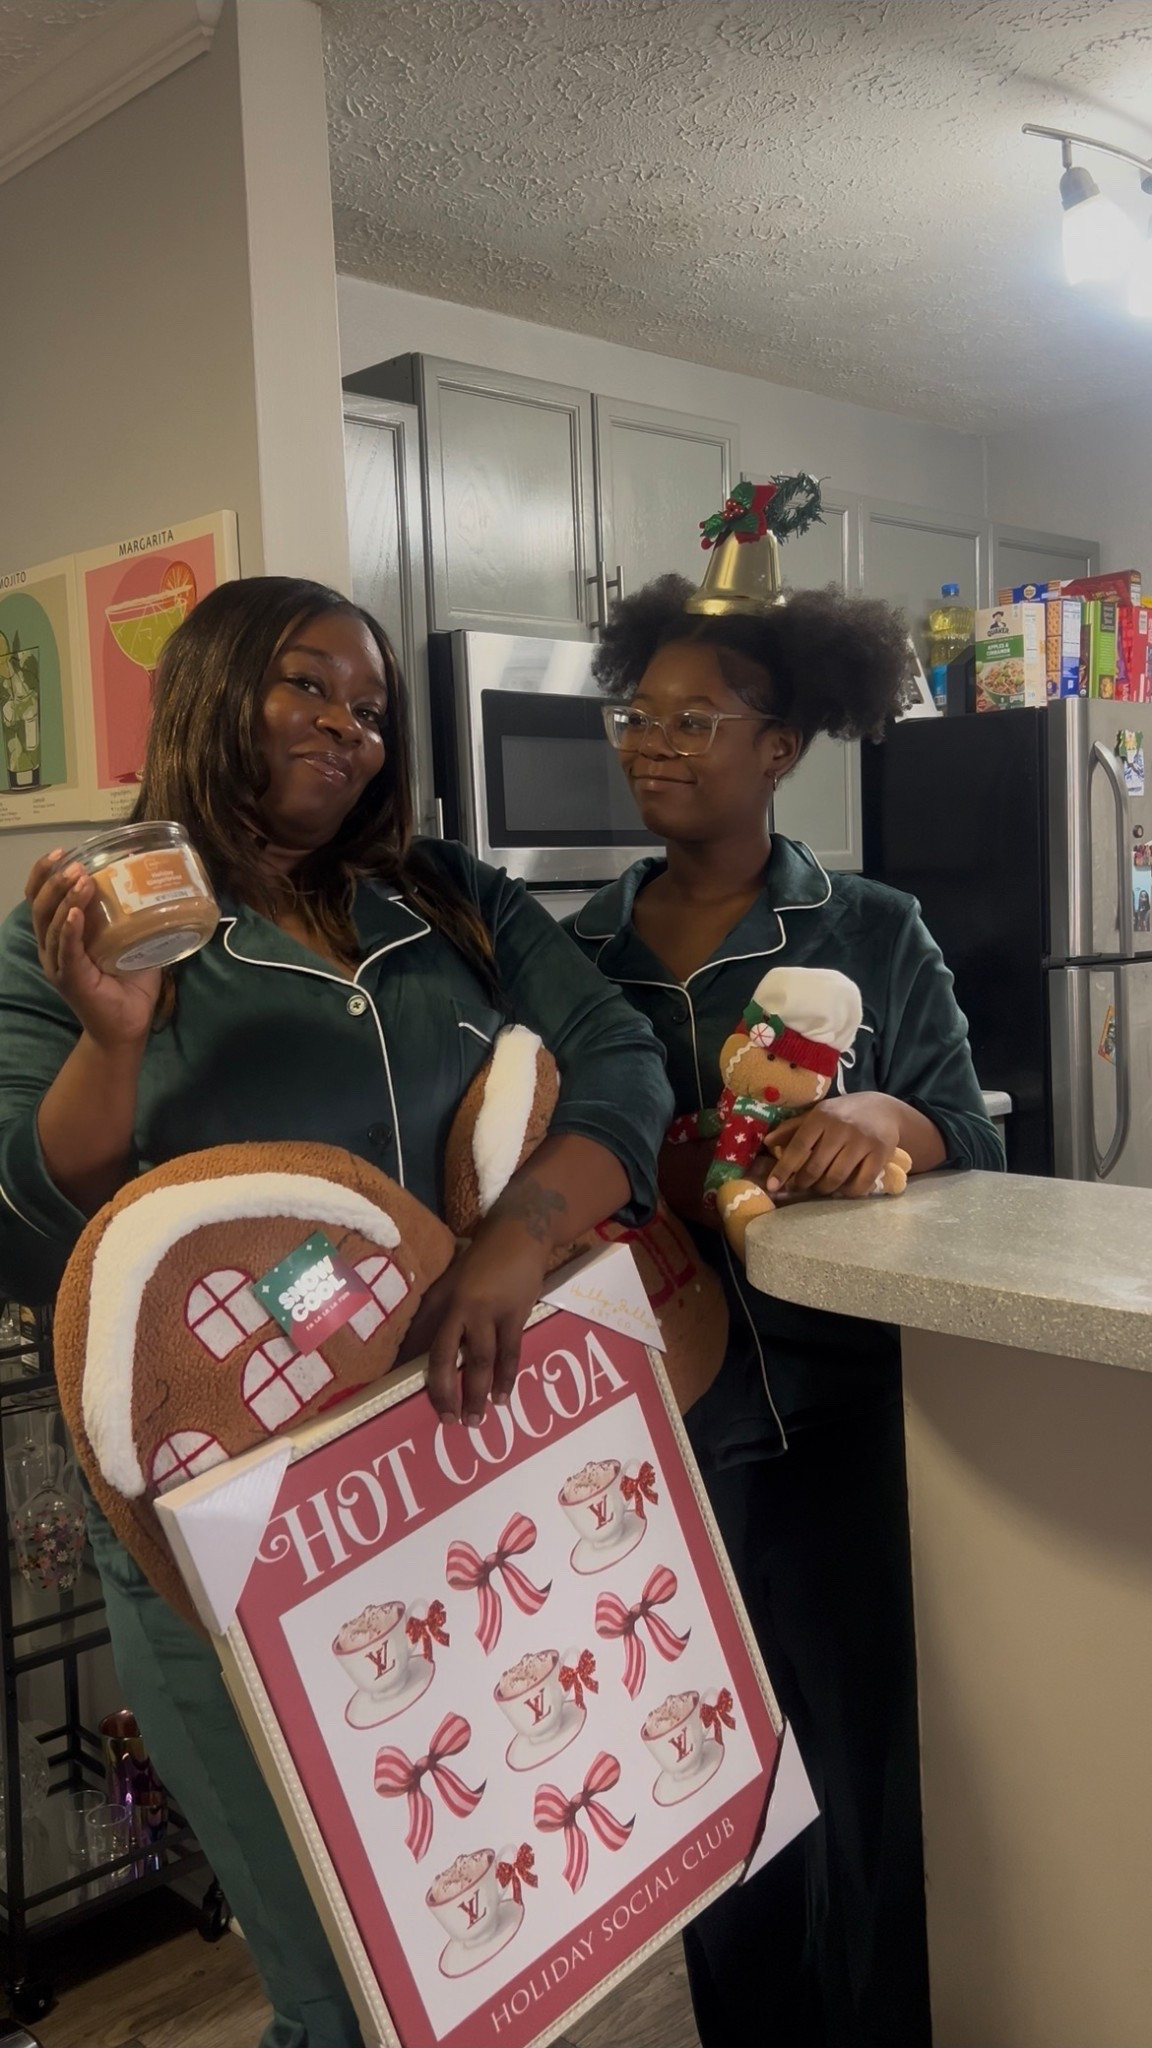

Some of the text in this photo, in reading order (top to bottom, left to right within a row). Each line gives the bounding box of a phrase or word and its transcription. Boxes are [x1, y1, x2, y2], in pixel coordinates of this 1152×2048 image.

[118, 529, 174, 557] MARGARITA
[278, 1254, 335, 1311] SNOW
[291, 1273, 347, 1322] COOL
[255, 1329, 629, 1587] HOT COCOA
[490, 1817, 735, 2033] HOLIDAY SOCIAL CLUB
